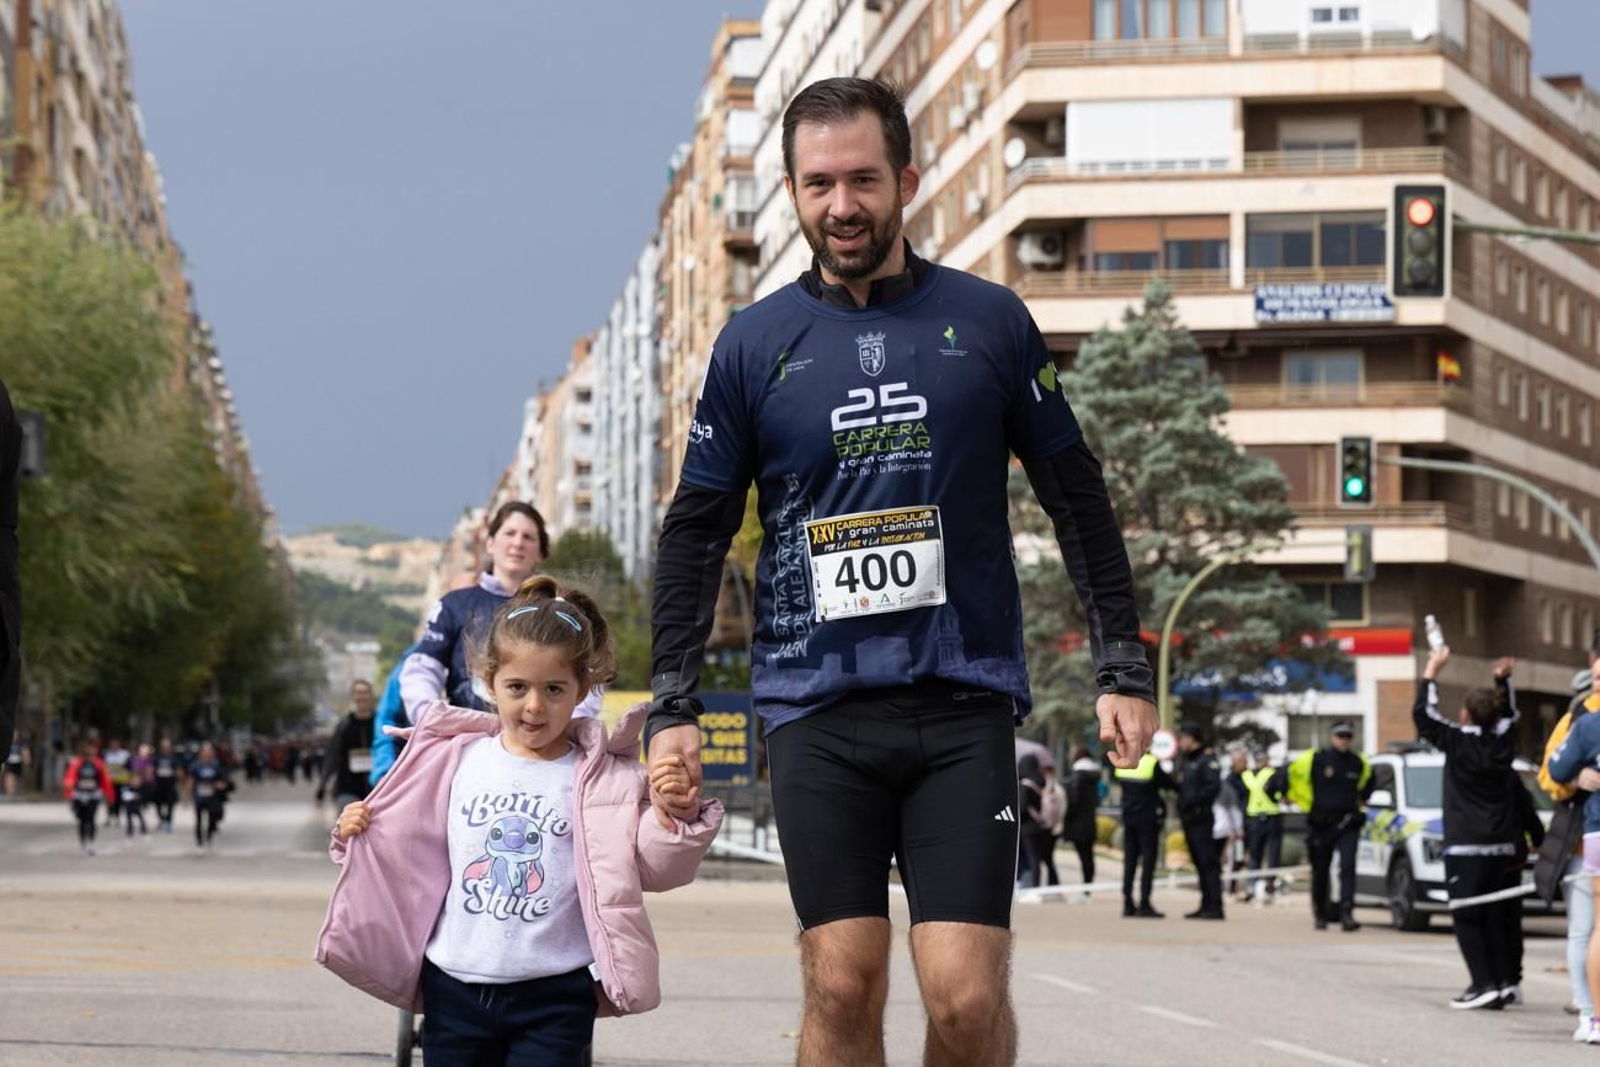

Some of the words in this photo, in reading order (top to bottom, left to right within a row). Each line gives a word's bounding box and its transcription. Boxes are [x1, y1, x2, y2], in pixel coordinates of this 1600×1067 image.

[831, 382, 928, 431] 25
[833, 422, 928, 446] CARRERA
[837, 436, 931, 458] POPULAR
[839, 461, 845, 470] y
[848, 455, 875, 468] gran
[877, 450, 933, 462] caminata
[836, 517, 883, 530] CARRERA
[884, 511, 933, 524] POPULA
[849, 527, 877, 539] gran
[882, 519, 934, 532] caminata
[811, 523, 835, 545] XXV
[835, 550, 917, 594] 400
[778, 583, 791, 635] SANTA
[794, 613, 807, 635] DE
[461, 793, 545, 827] Born
[538, 808, 572, 837] to
[461, 877, 551, 923] Shine
